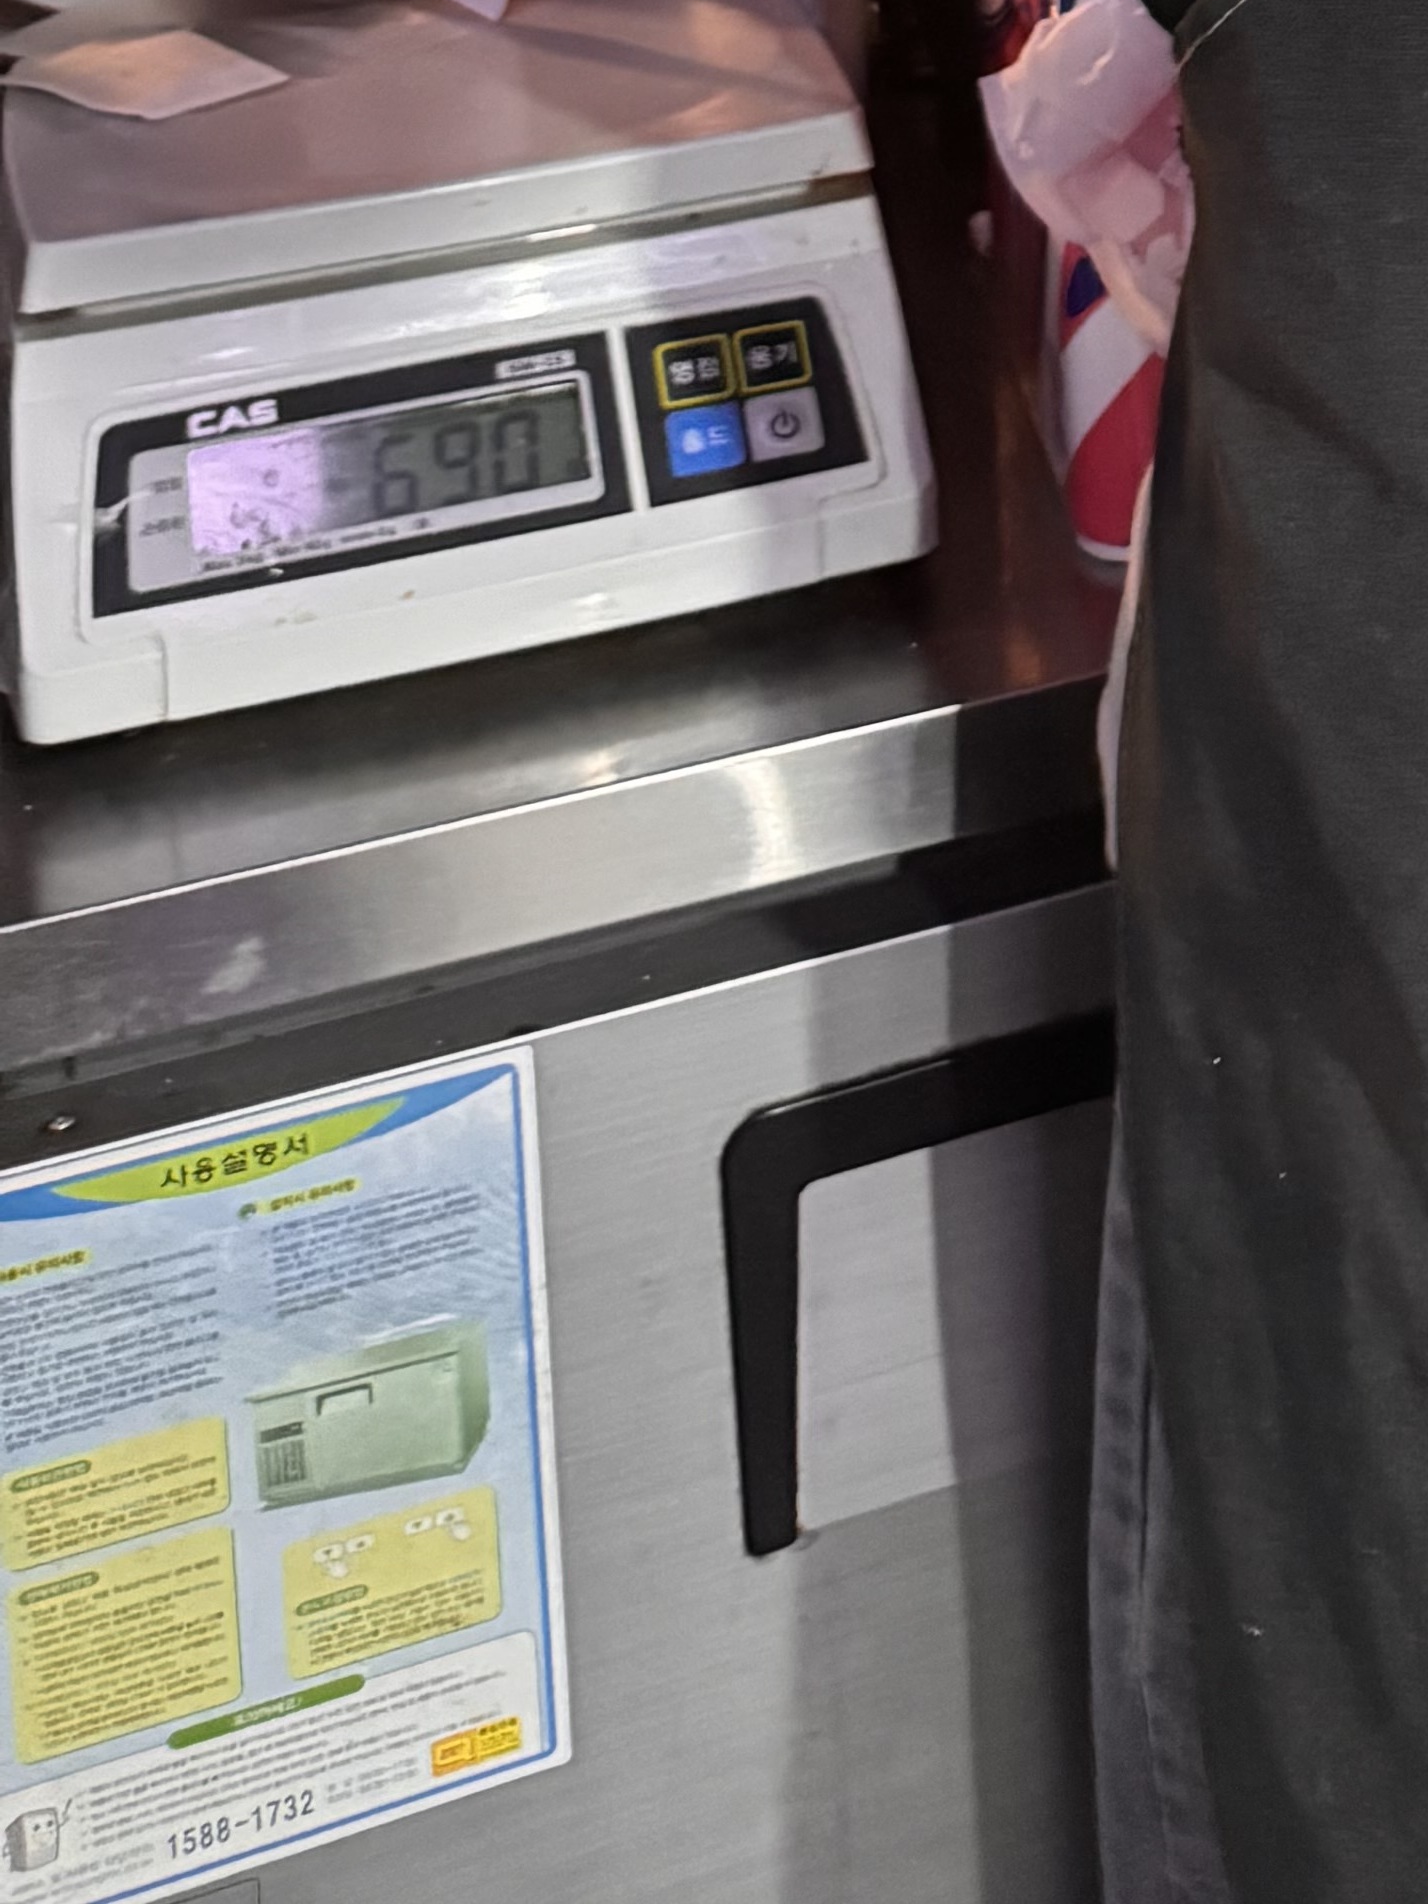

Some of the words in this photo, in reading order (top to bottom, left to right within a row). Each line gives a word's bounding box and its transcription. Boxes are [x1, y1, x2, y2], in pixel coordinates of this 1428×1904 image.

[187, 399, 279, 439] CAS
[375, 409, 541, 516] 690
[160, 1132, 311, 1189] 사용설명서
[167, 1789, 316, 1859] 1588-1732
